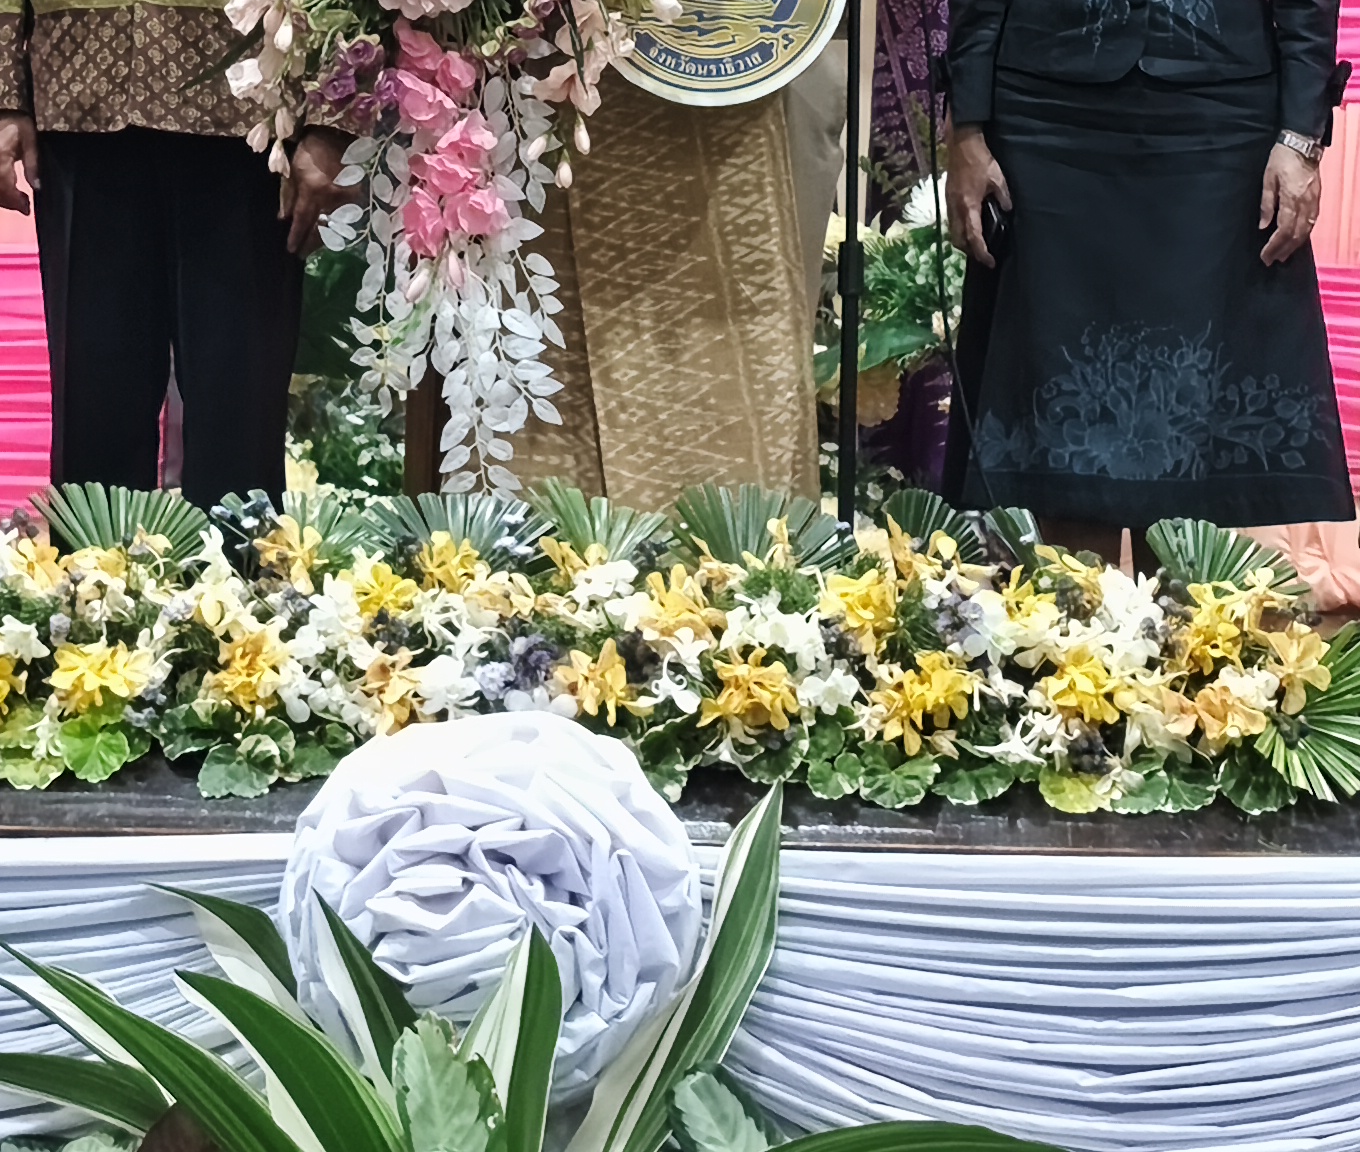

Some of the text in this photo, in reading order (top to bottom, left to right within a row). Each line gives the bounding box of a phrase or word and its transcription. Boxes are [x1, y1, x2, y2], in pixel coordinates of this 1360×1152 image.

[647, 42, 763, 77] จังหวัดนราธิวาส
